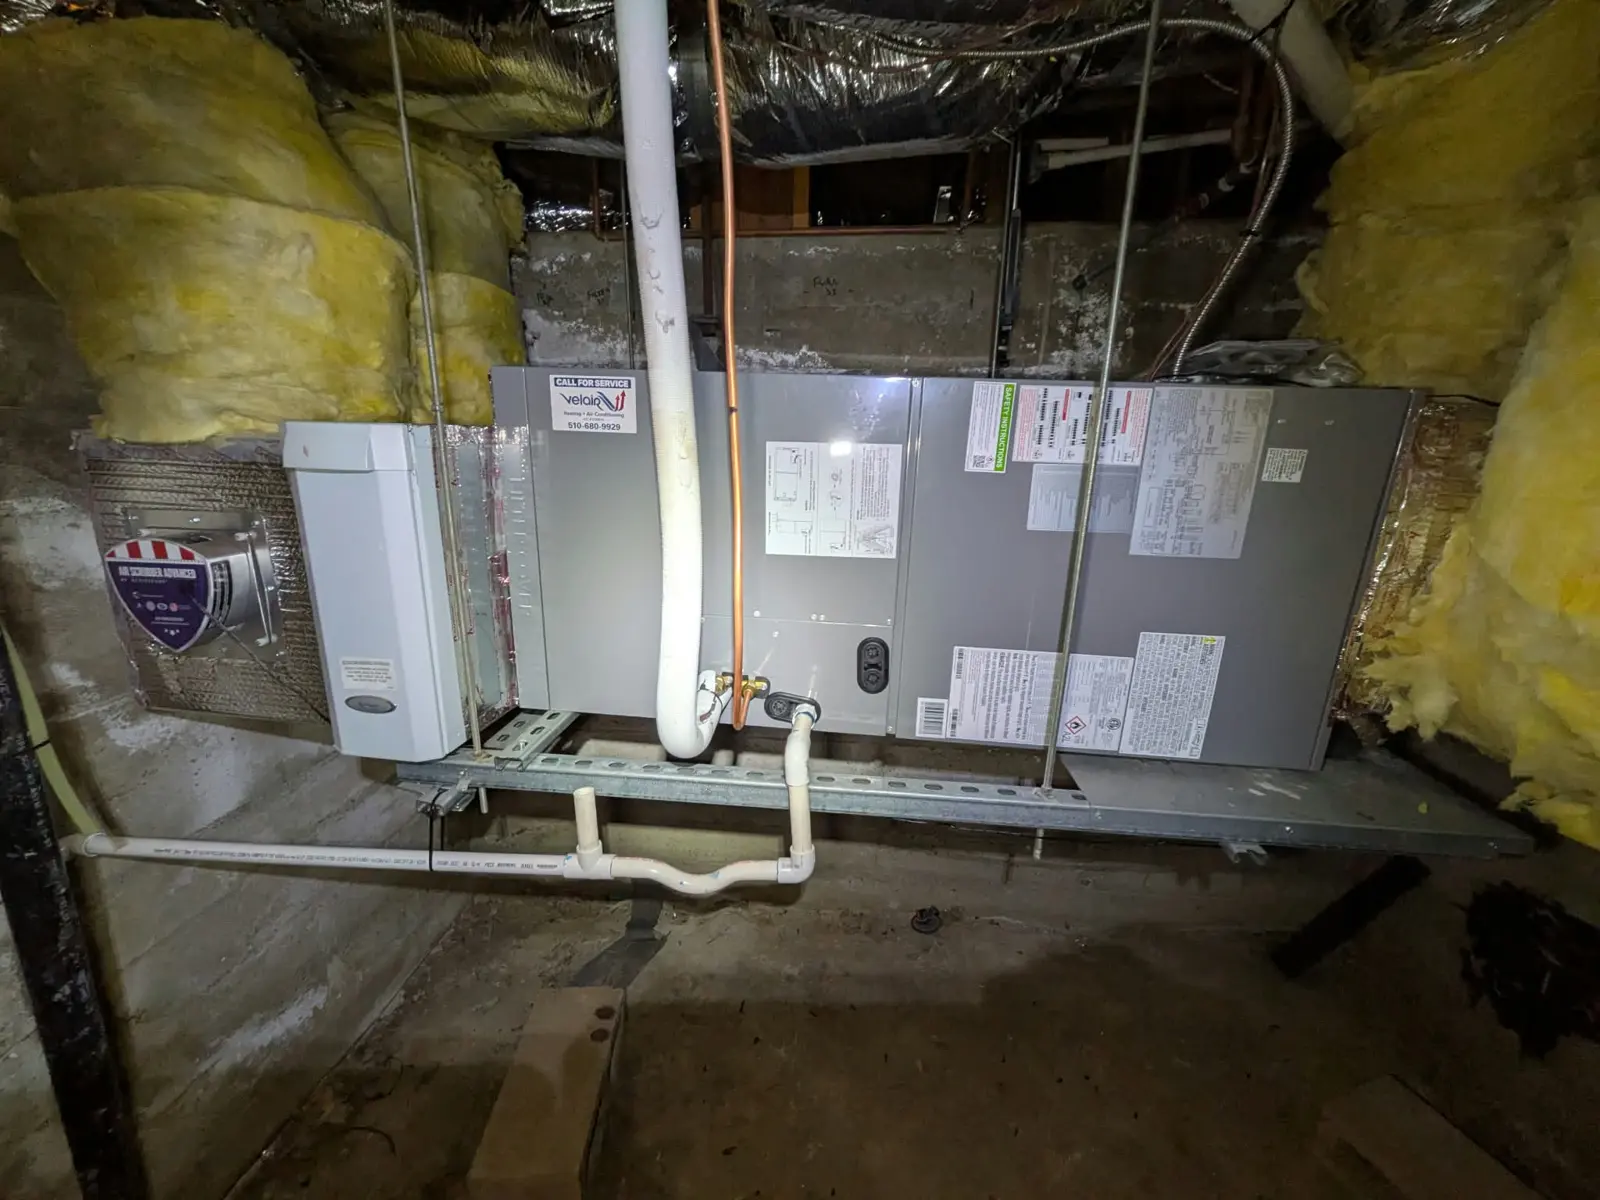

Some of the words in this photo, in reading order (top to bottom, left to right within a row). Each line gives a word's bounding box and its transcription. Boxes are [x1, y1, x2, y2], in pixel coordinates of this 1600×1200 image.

[556, 378, 577, 386] CALL
[577, 379, 594, 387] FOR
[594, 379, 629, 388] SERVICE
[1002, 387, 1012, 415] SAFETY
[568, 421, 621, 431] 510-680-9929
[995, 416, 1009, 468] INSTRUCTIONS
[1062, 730, 1071, 743] A2L
